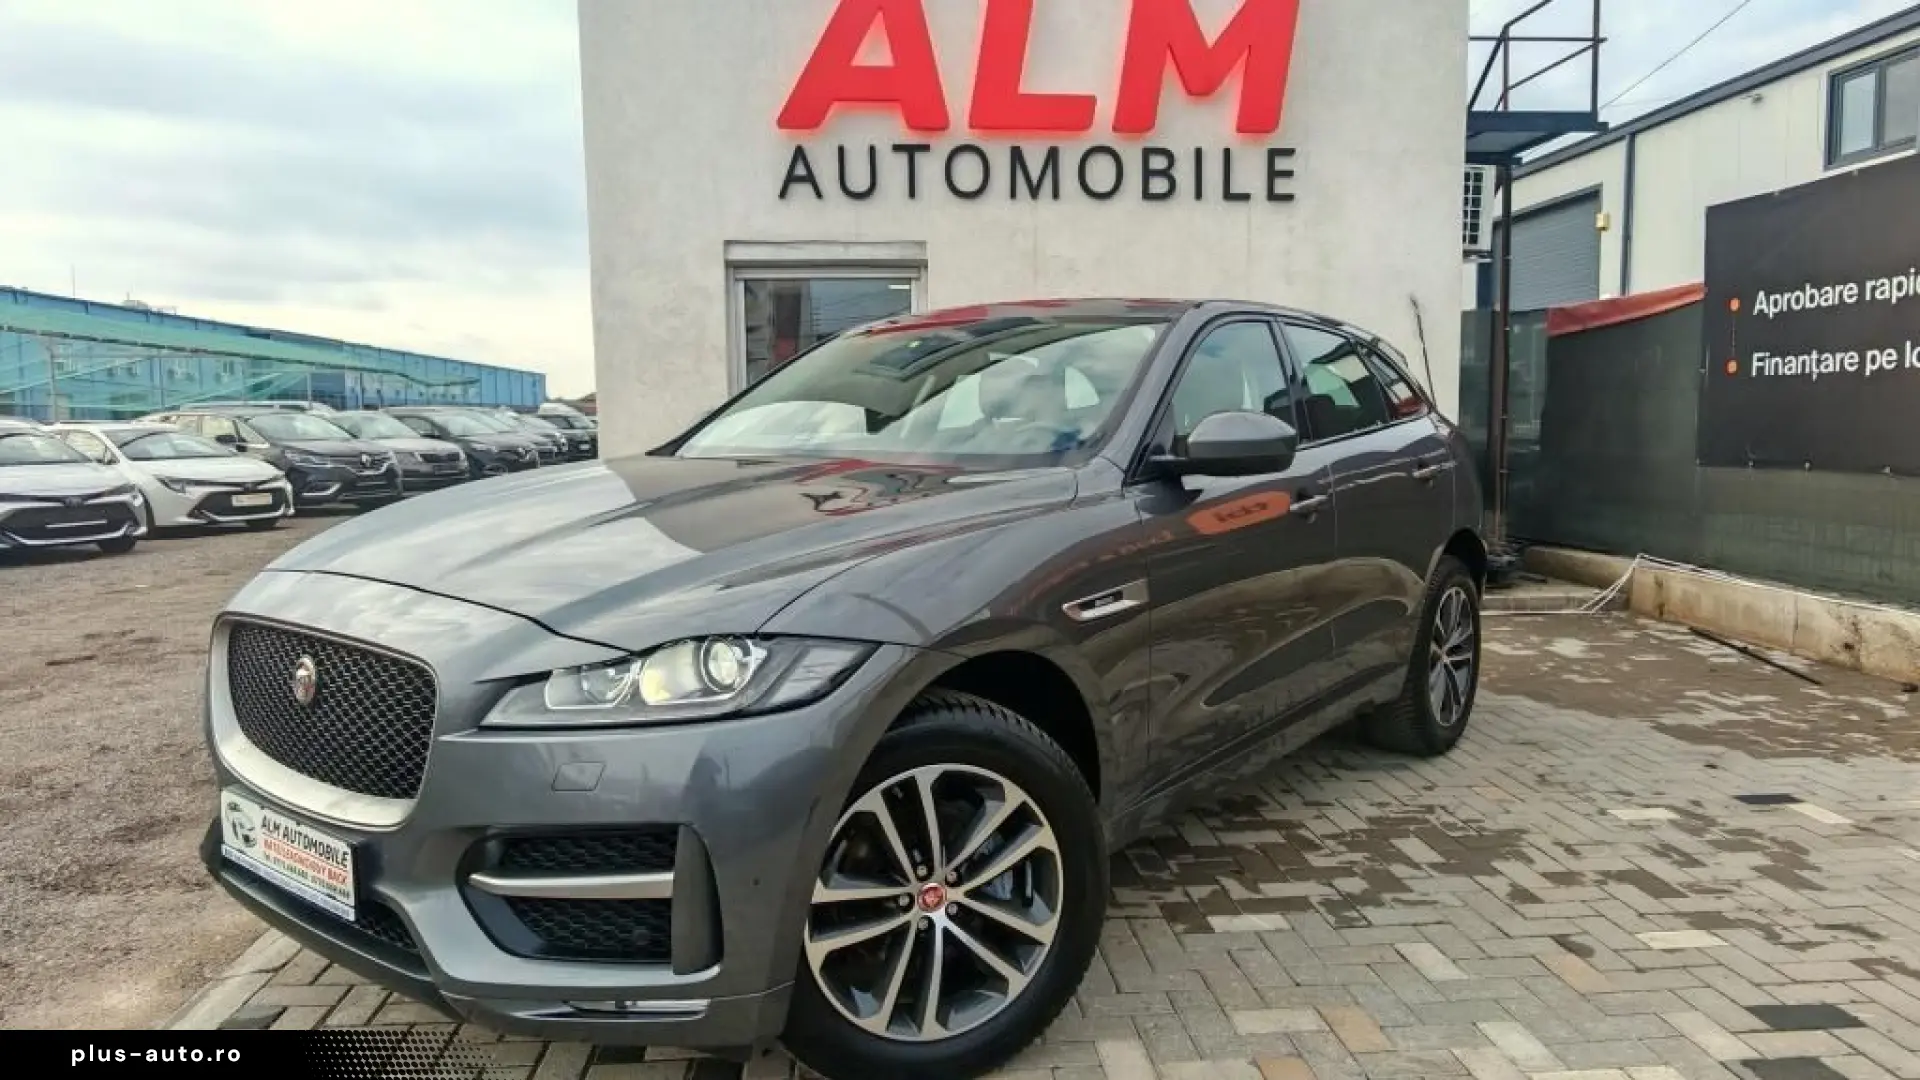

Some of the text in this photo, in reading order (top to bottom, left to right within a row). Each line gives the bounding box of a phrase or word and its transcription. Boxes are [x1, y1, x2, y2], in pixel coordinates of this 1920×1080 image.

[777, 0, 1300, 133] ALM
[778, 143, 1297, 202] AUTOMOBILE
[1753, 283, 1859, 319] Aprobare
[1751, 349, 1860, 382] Finanțare
[1865, 348, 1899, 376] pe
[261, 814, 282, 836] ALM
[283, 826, 349, 867] AUTOMOBILE
